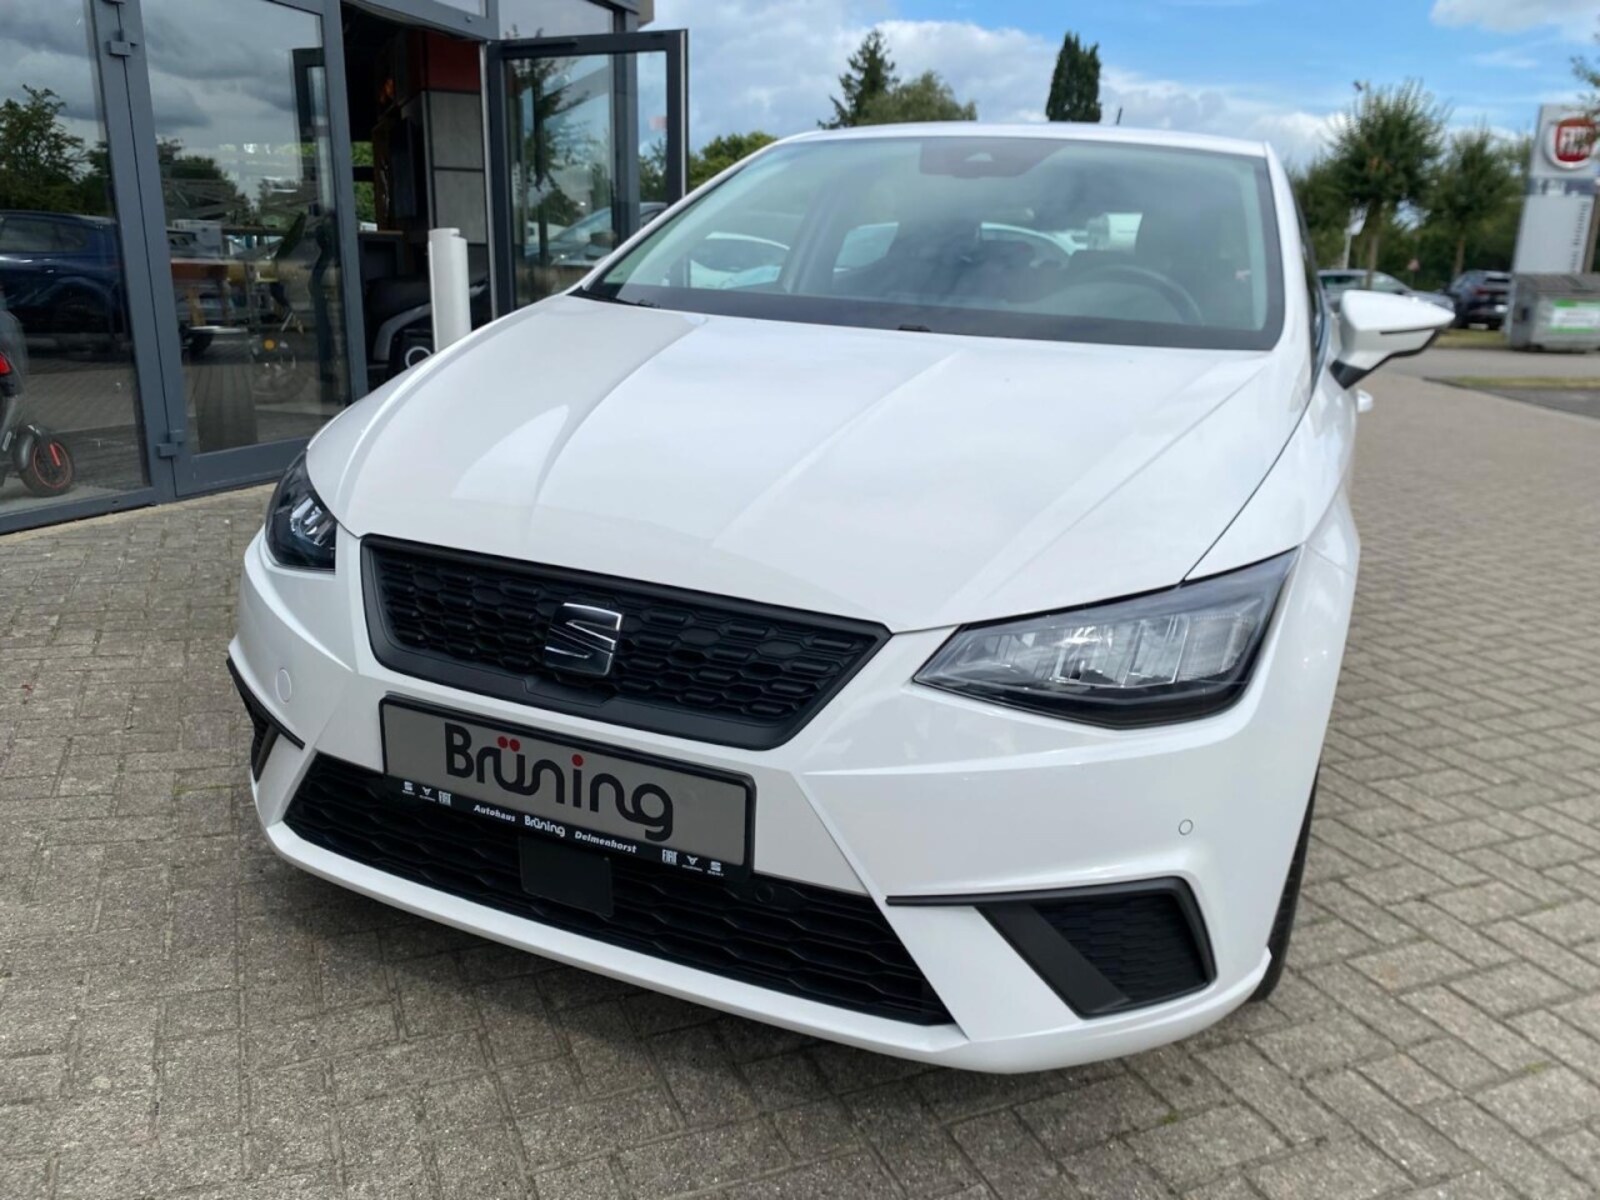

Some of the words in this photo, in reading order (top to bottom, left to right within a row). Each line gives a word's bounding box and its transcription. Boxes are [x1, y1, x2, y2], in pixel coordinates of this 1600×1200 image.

[444, 722, 674, 842] Brüning
[473, 804, 516, 822] Autohaus
[524, 815, 566, 837] Brüning
[575, 831, 637, 854] Delmenhorst
